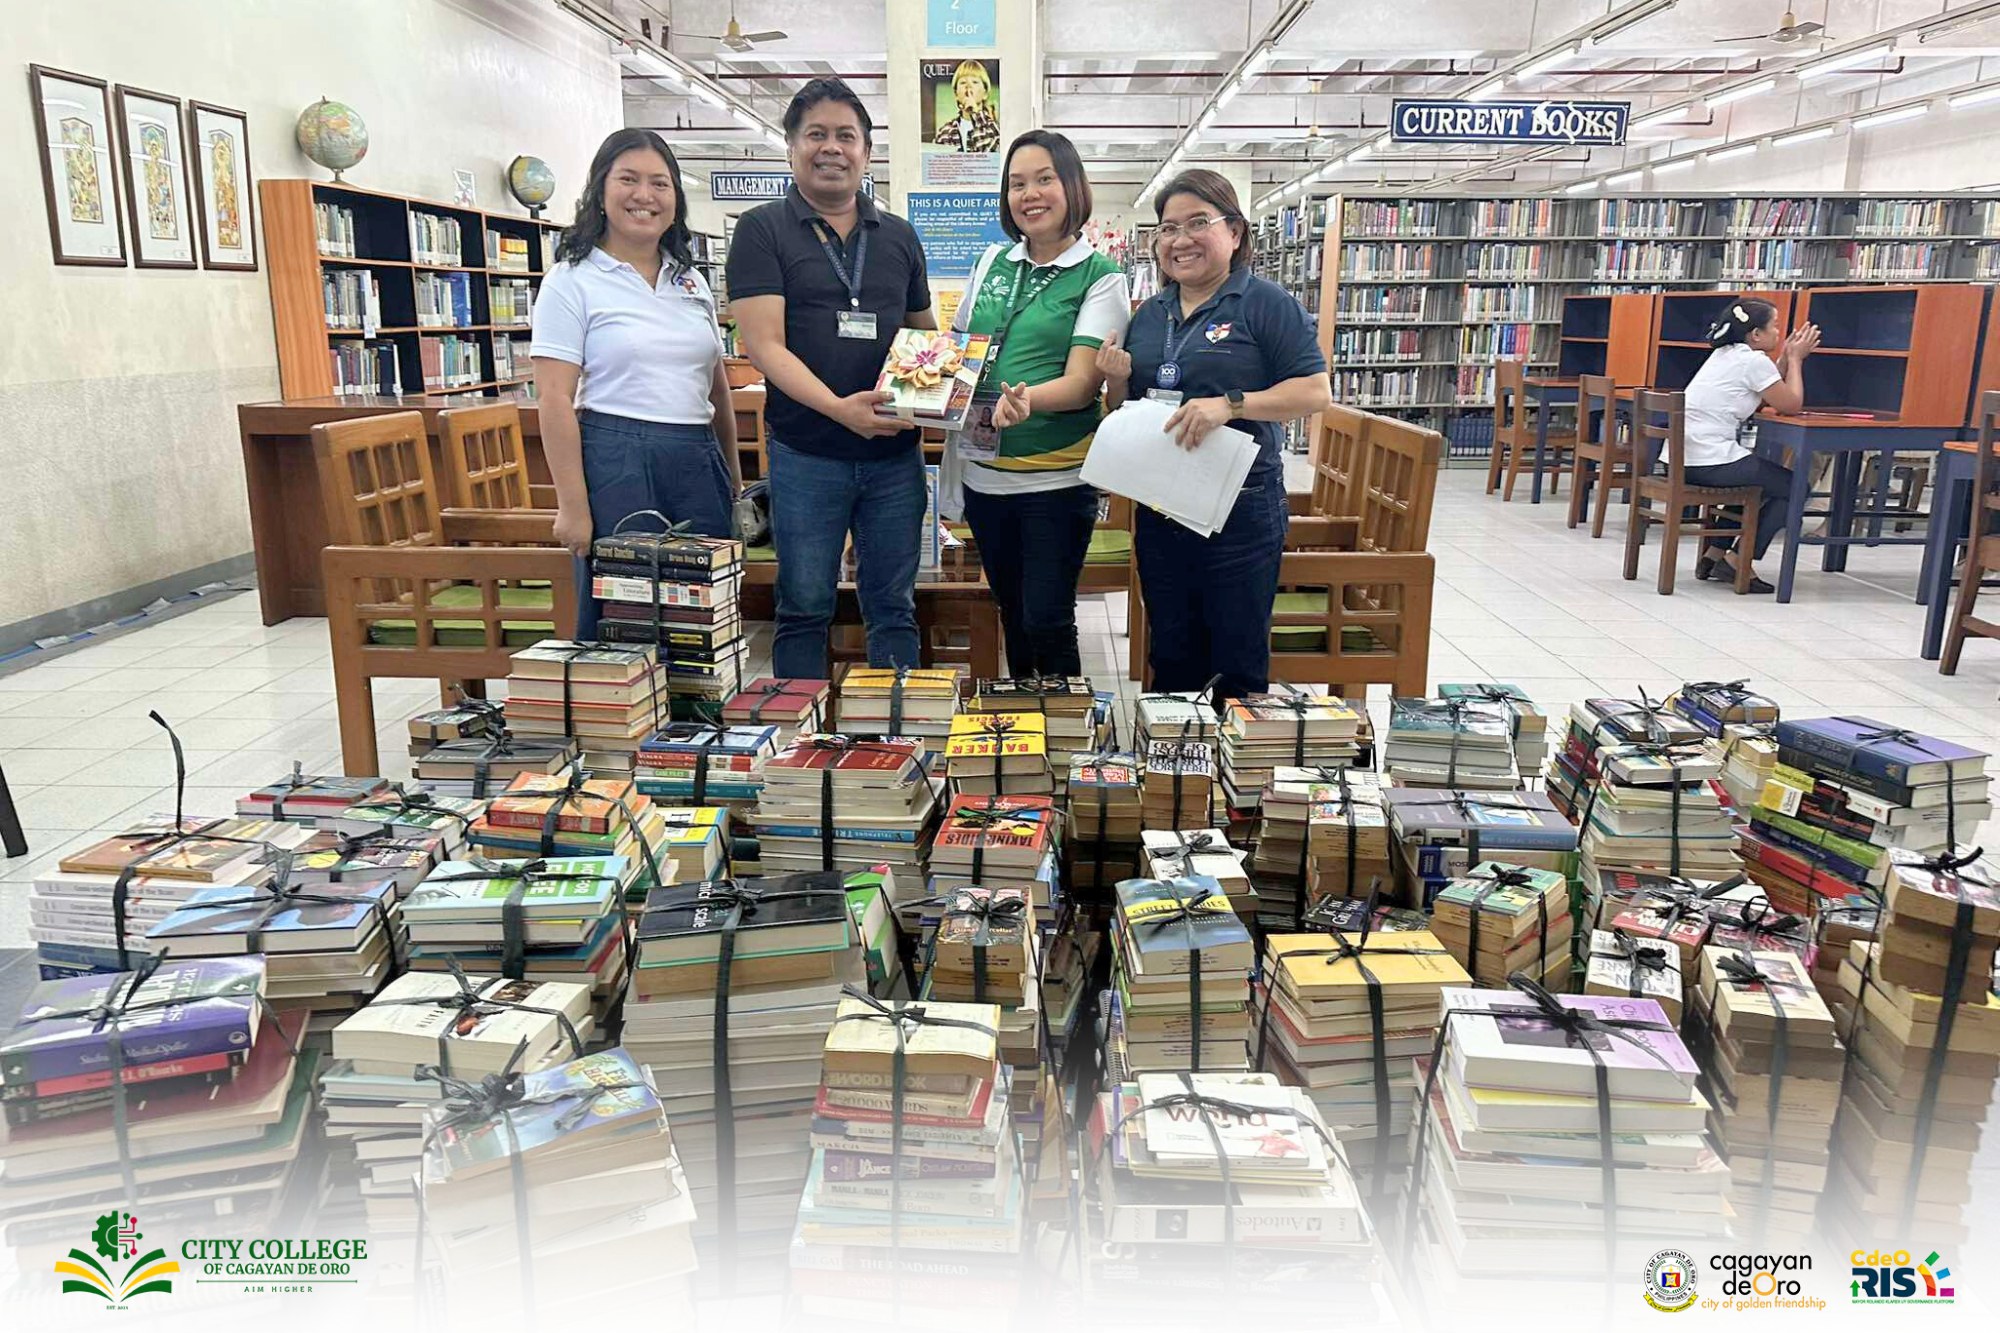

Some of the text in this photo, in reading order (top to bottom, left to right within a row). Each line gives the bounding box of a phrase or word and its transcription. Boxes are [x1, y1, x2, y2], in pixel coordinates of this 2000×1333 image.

[945, 21, 980, 34] Floor
[1402, 107, 1618, 138] CURRENT BOOKS
[717, 176, 785, 196] MANAGEMENT
[910, 198, 931, 208] THIS
[933, 198, 941, 208] IS
[943, 198, 951, 208] A
[952, 198, 981, 209] QUIET
[691, 905, 711, 929] scale
[837, 1074, 882, 1087] WORD
[1233, 1215, 1304, 1230] Autodes
